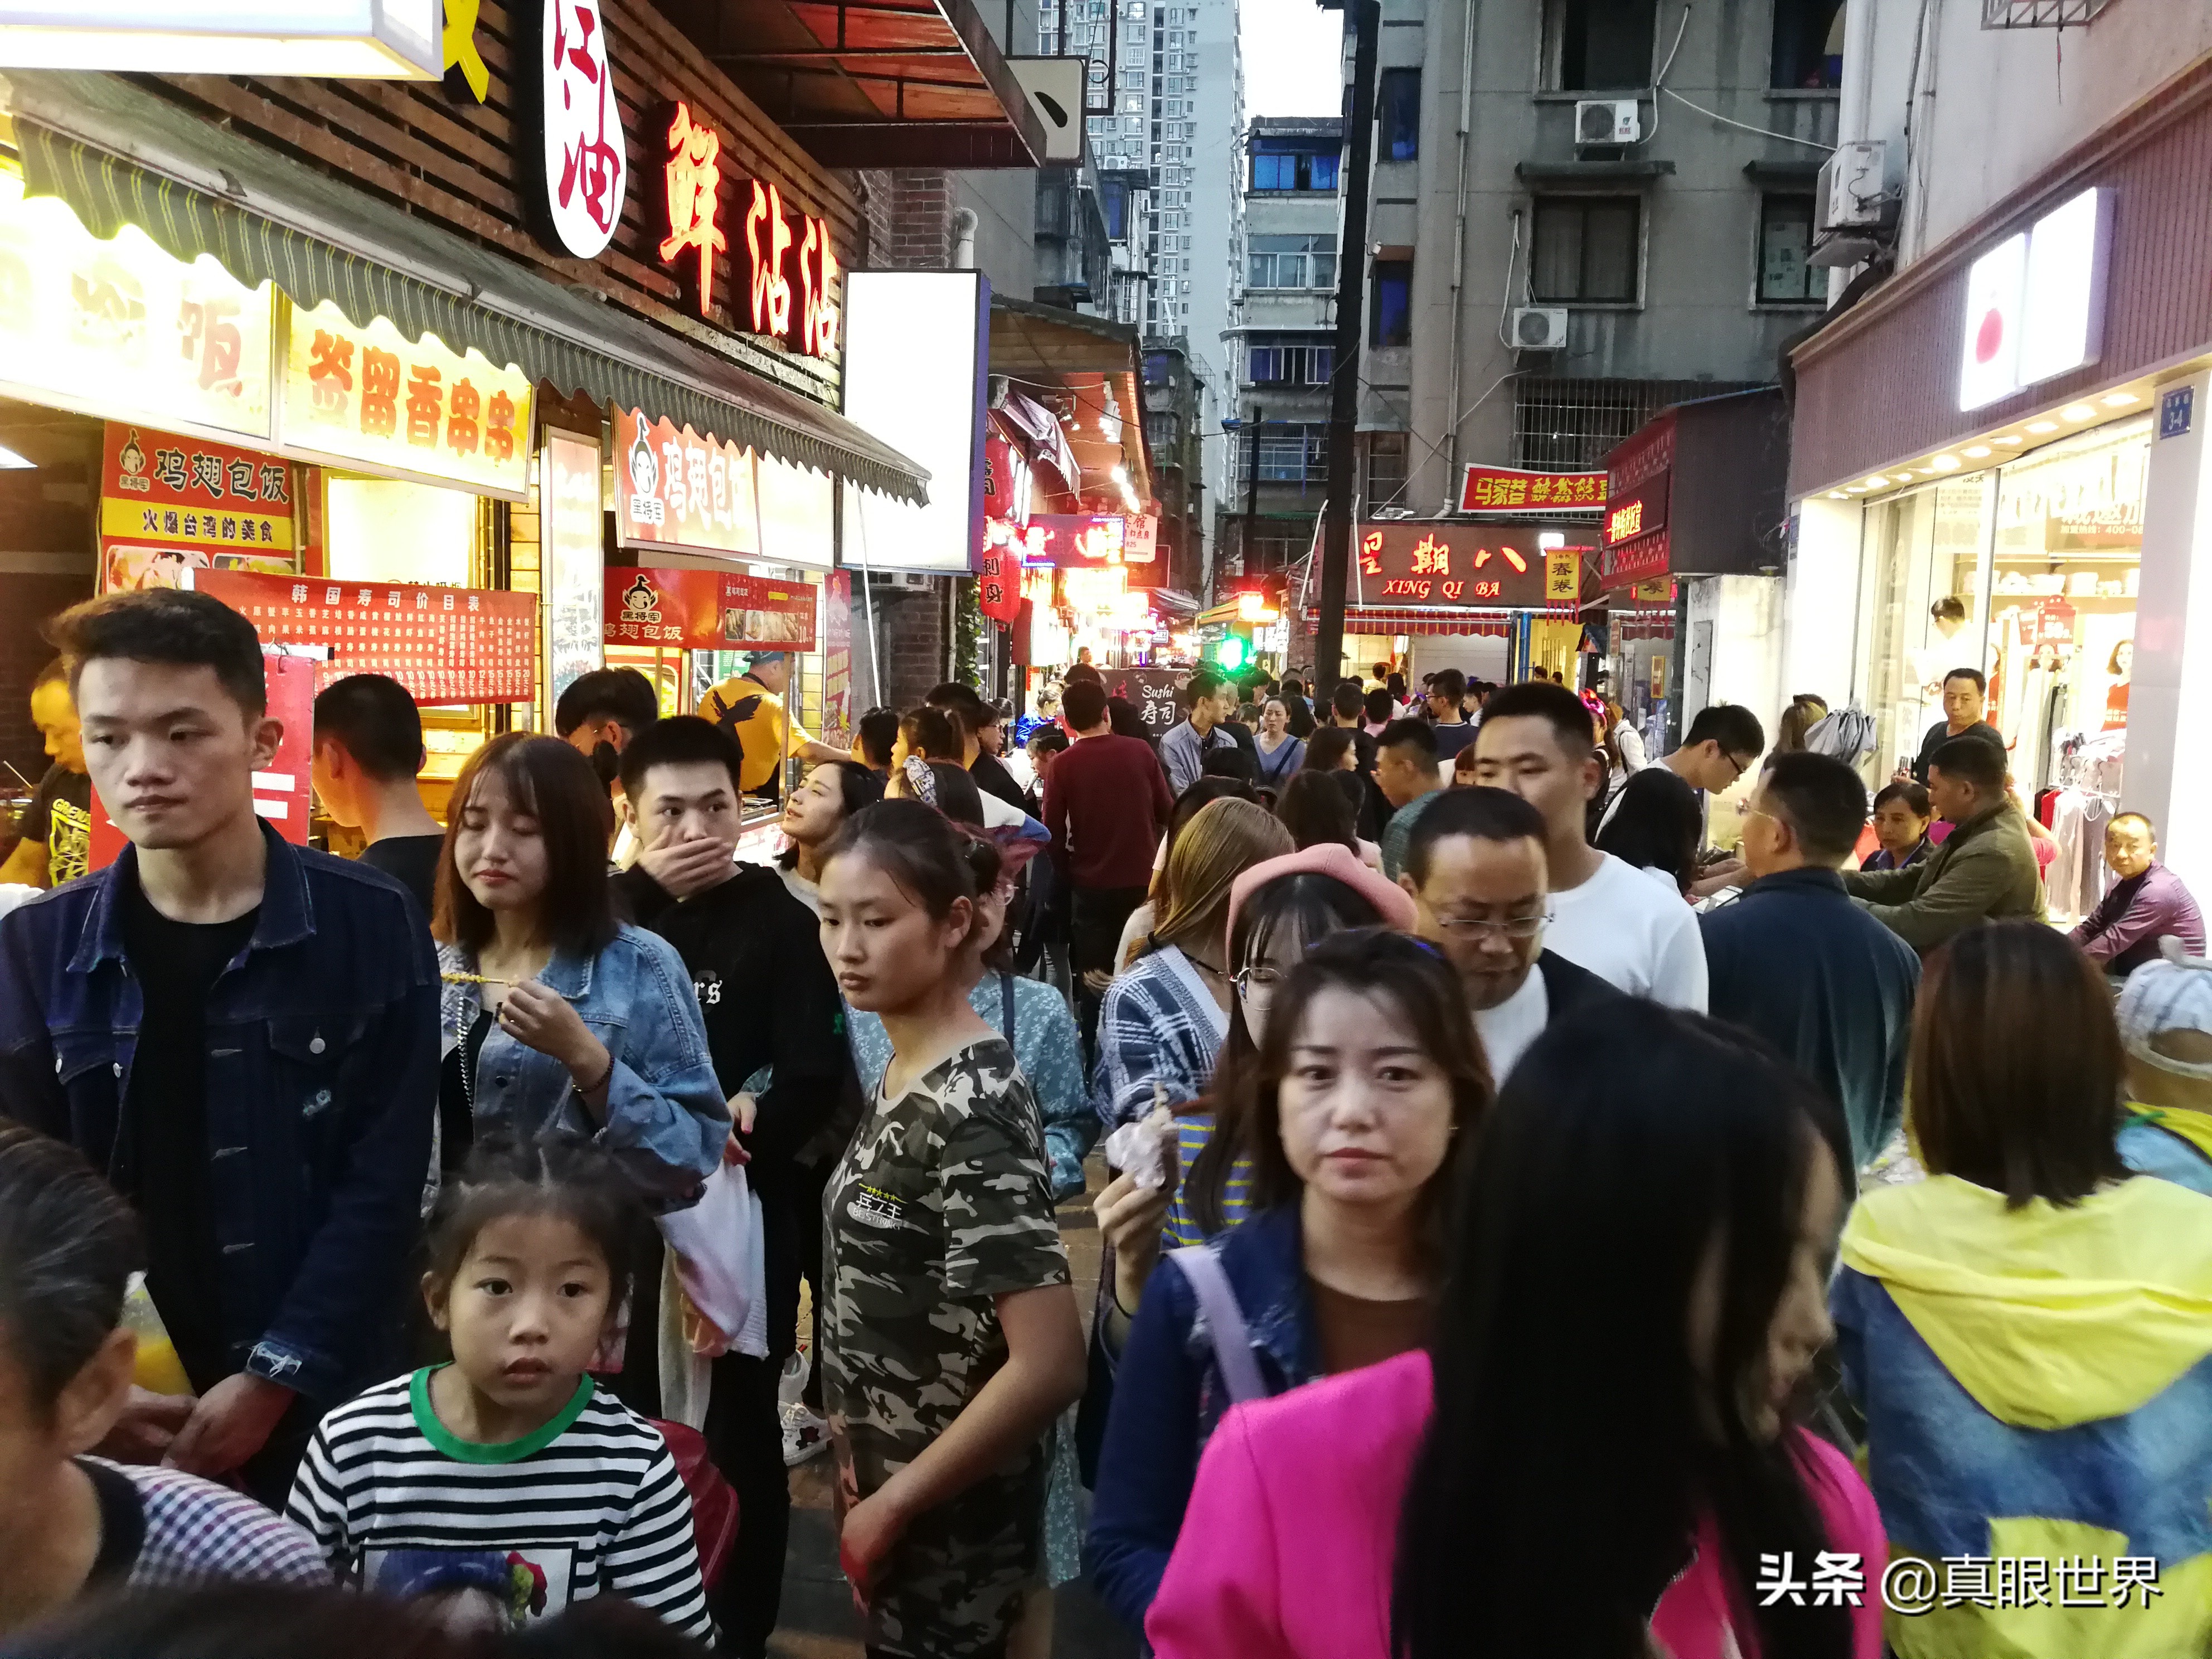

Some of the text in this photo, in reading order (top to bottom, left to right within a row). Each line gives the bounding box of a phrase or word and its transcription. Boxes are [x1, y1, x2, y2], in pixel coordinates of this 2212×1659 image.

[554, 0, 620, 234] 江油
[153, 447, 289, 504] 鸡翅包饭
[143, 508, 274, 543] 火爆台湾的美食
[1360, 531, 1527, 576] 星期八
[983, 557, 1003, 604] 刺身
[1382, 579, 1501, 600] XING QI BA
[292, 584, 479, 612] 韩国寿司价目表
[622, 610, 660, 622] 黑将军
[604, 623, 684, 641] 鸡翅包饭
[1142, 683, 1175, 699] Sushi
[1140, 700, 1176, 725] 寿司
